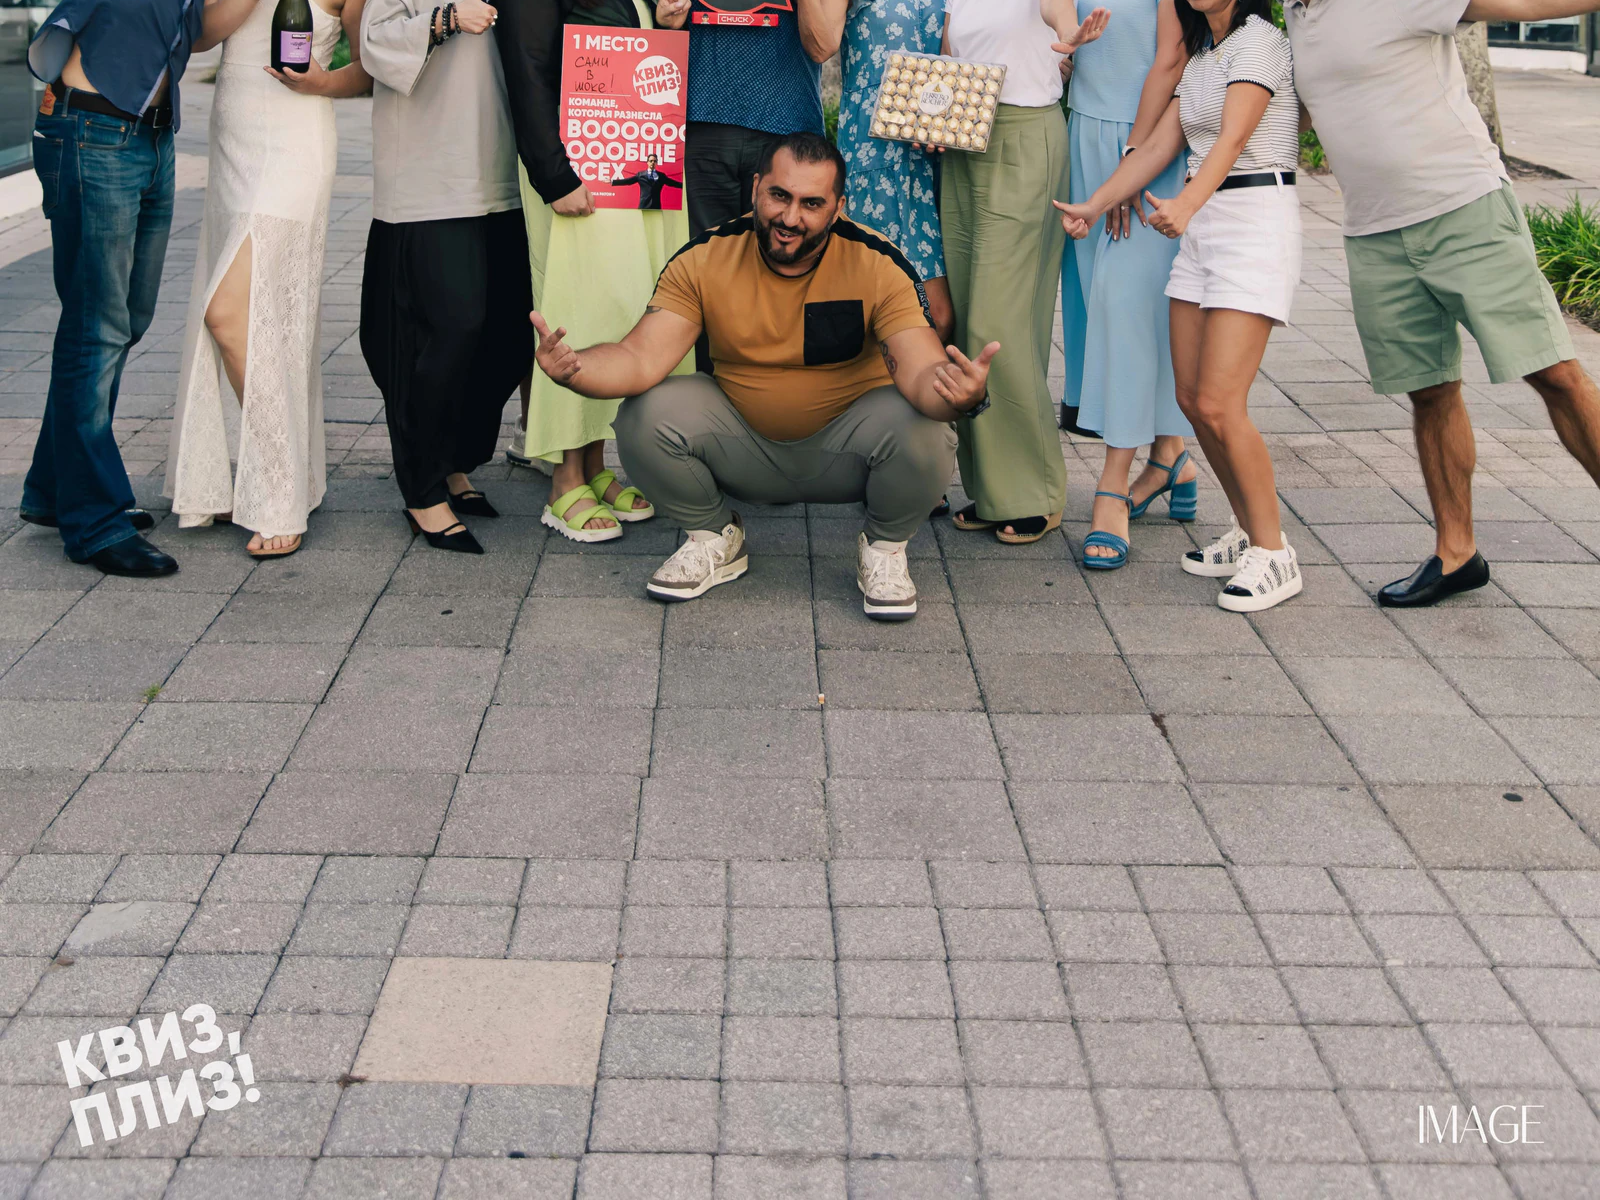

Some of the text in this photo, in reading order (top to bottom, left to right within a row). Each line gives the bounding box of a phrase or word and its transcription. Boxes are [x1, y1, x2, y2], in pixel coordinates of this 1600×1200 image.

[720, 15, 749, 23] CHUCK
[573, 34, 649, 53] 1 МЕСТО
[635, 62, 679, 83] КВИЗ,
[636, 76, 681, 97] ПЛИЗ!
[568, 97, 618, 108] КОМАНДЕ,
[568, 108, 663, 120] КОТОРАЯ РАЗНЕСЛА
[566, 140, 676, 166] ОООБЩЕ
